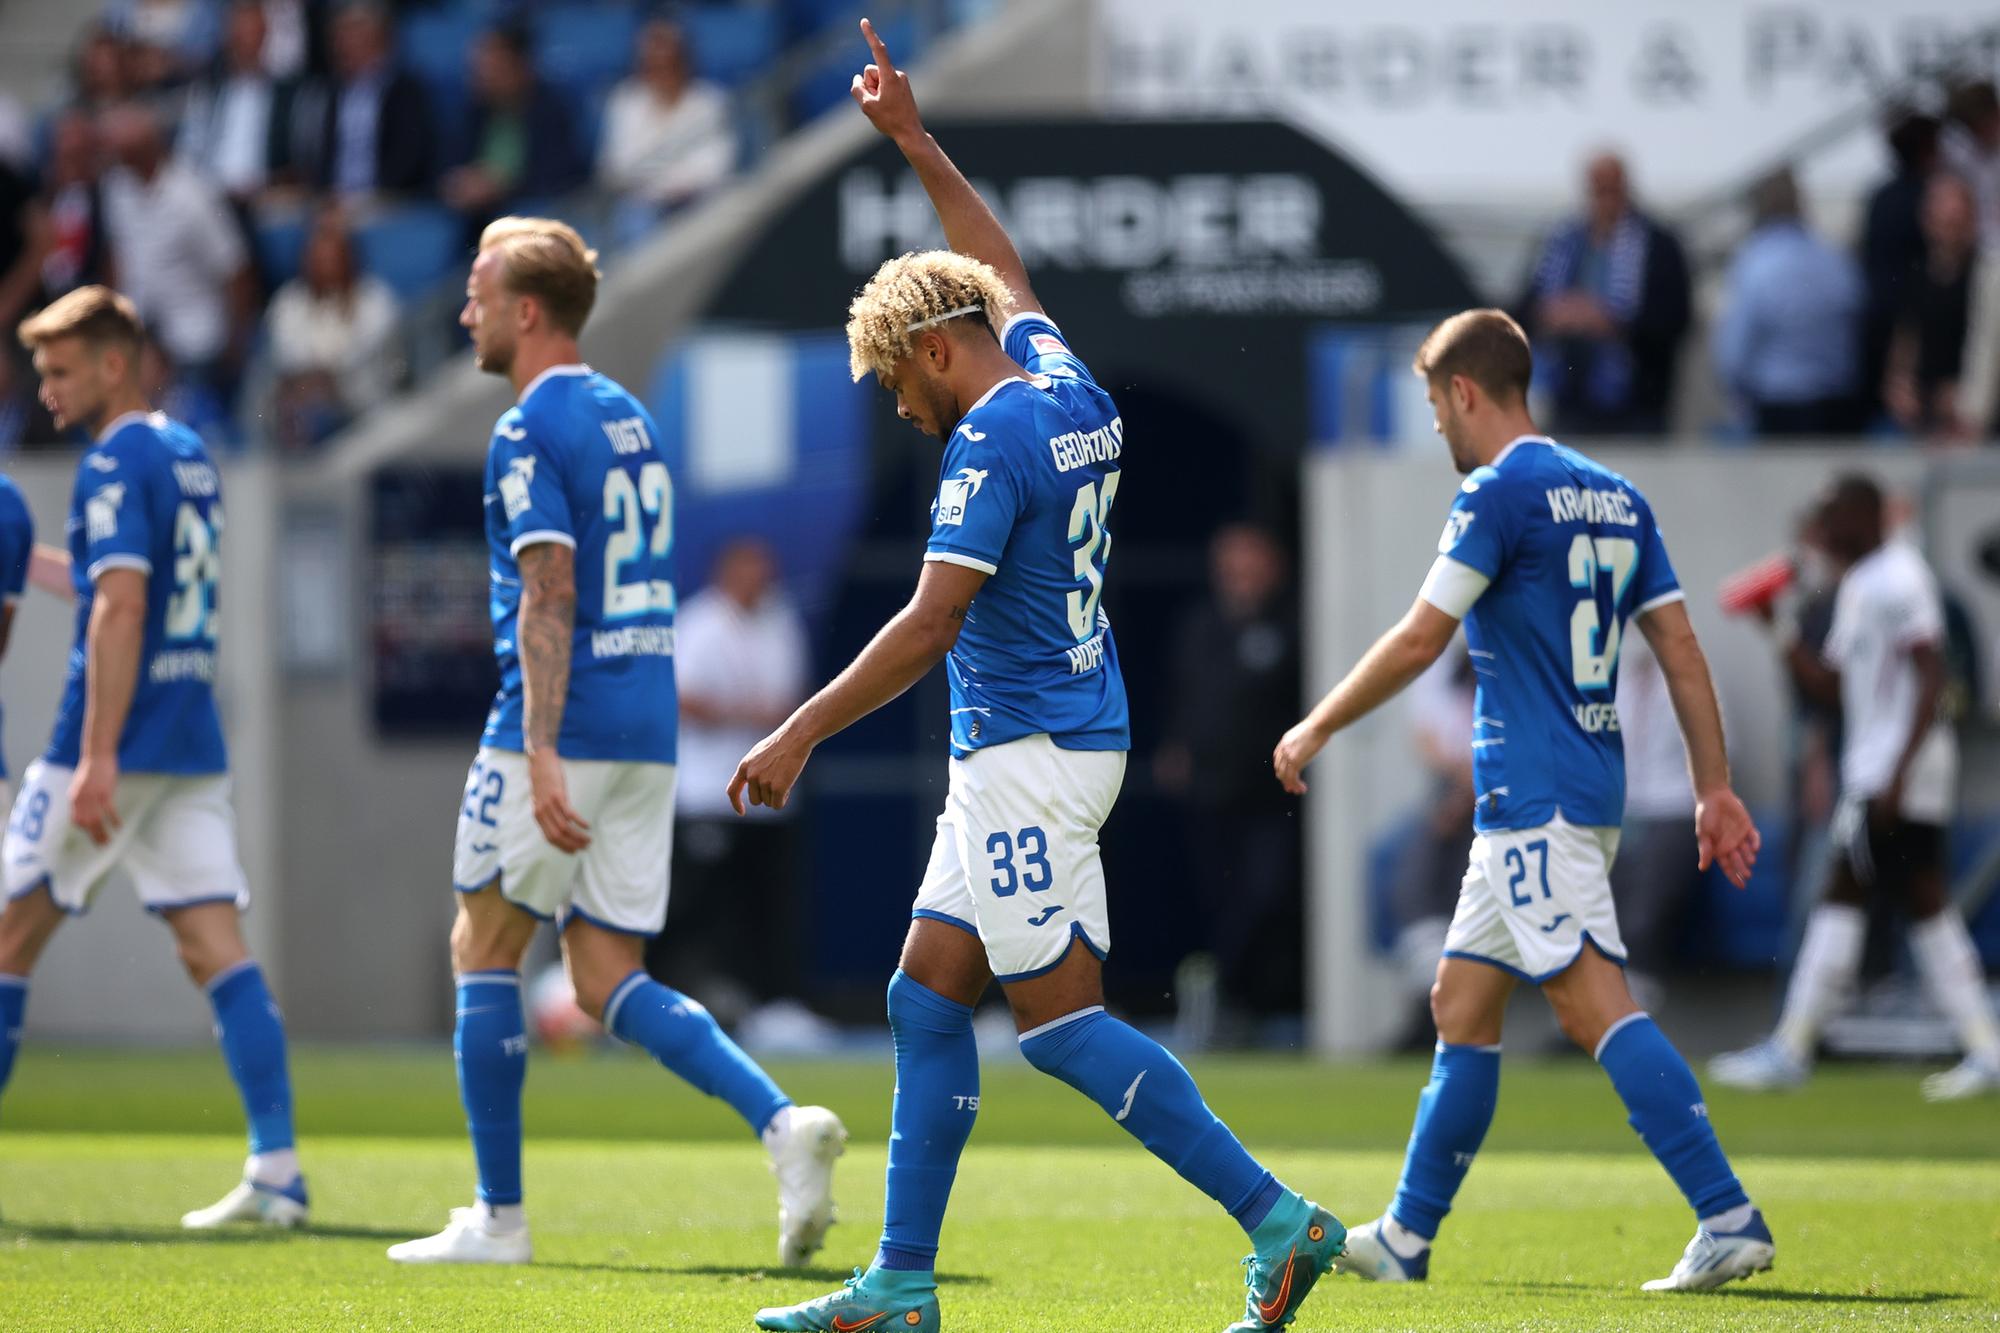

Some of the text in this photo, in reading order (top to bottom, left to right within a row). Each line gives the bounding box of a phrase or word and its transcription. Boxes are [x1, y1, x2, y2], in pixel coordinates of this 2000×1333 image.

[1106, 22, 1594, 112] HARDER
[840, 168, 1322, 272] HRDER
[602, 461, 677, 620] 22
[1568, 533, 1640, 690] 27
[986, 826, 1053, 897] 33
[1505, 839, 1551, 906] 27
